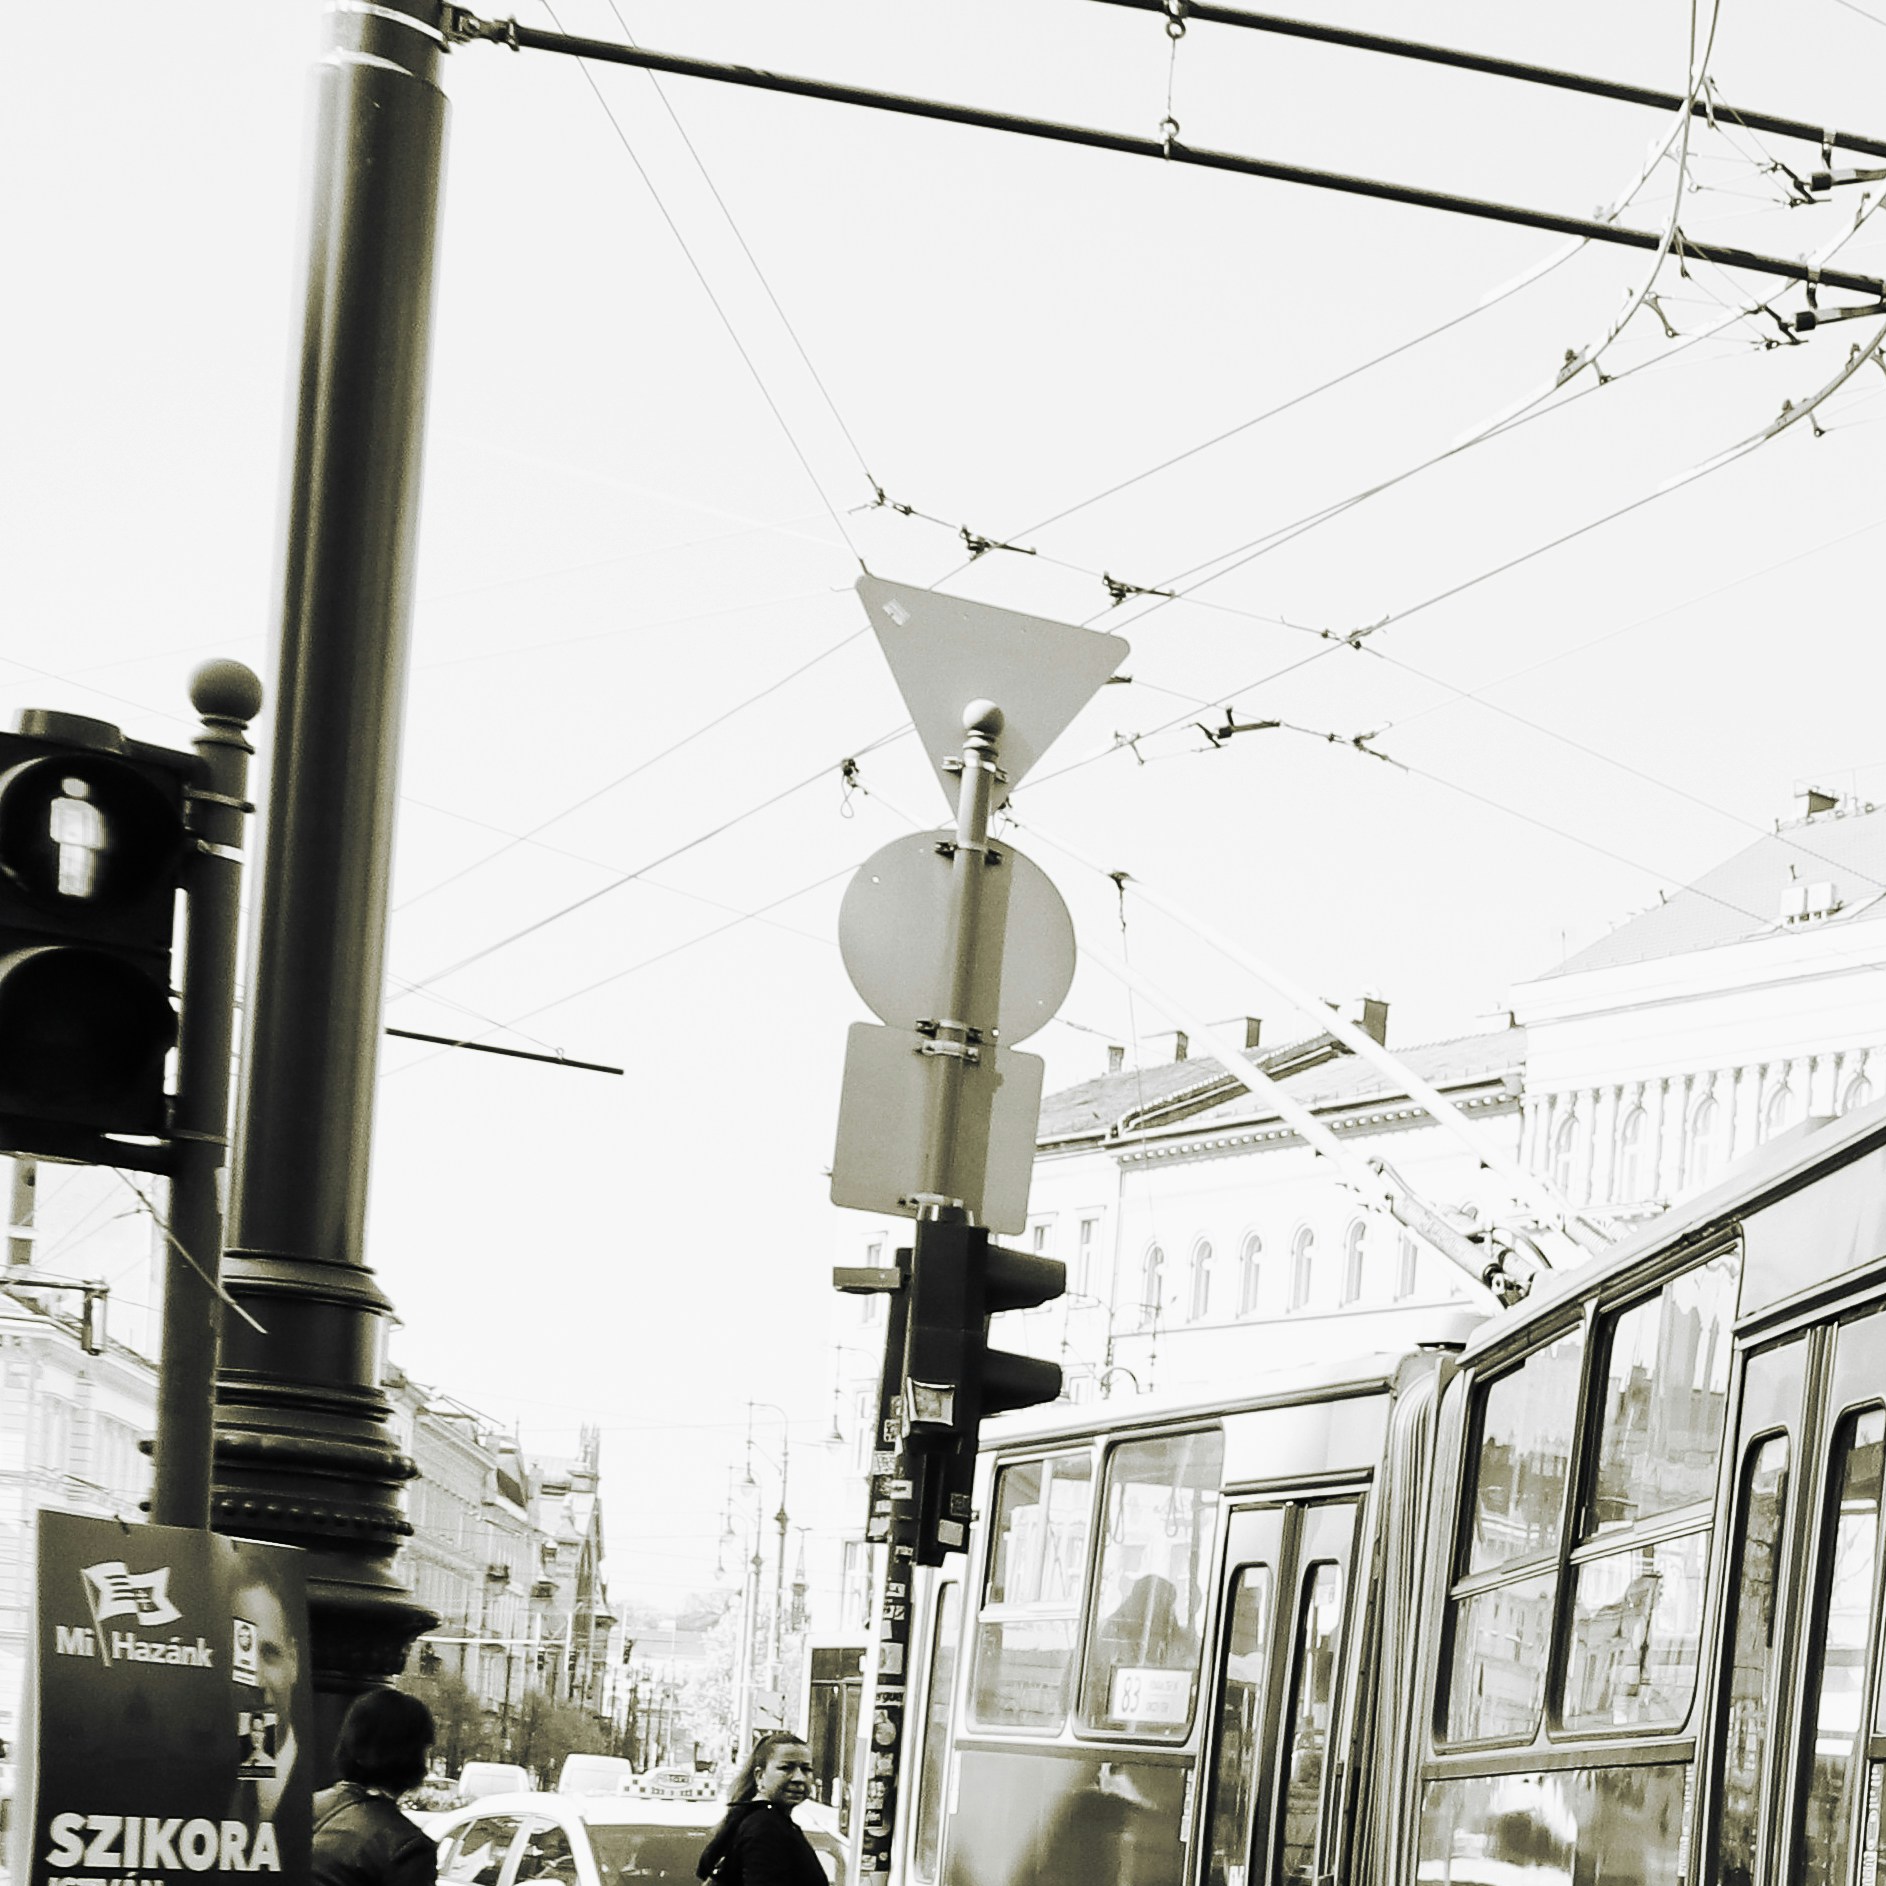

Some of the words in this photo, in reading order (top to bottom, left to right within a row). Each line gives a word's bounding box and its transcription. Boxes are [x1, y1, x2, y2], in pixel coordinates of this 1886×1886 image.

[55, 1624, 95, 1658] Mi
[110, 1629, 214, 1669] Hazánk
[1121, 1676, 1142, 1713] 83
[46, 1812, 281, 1872] SZIKORA
